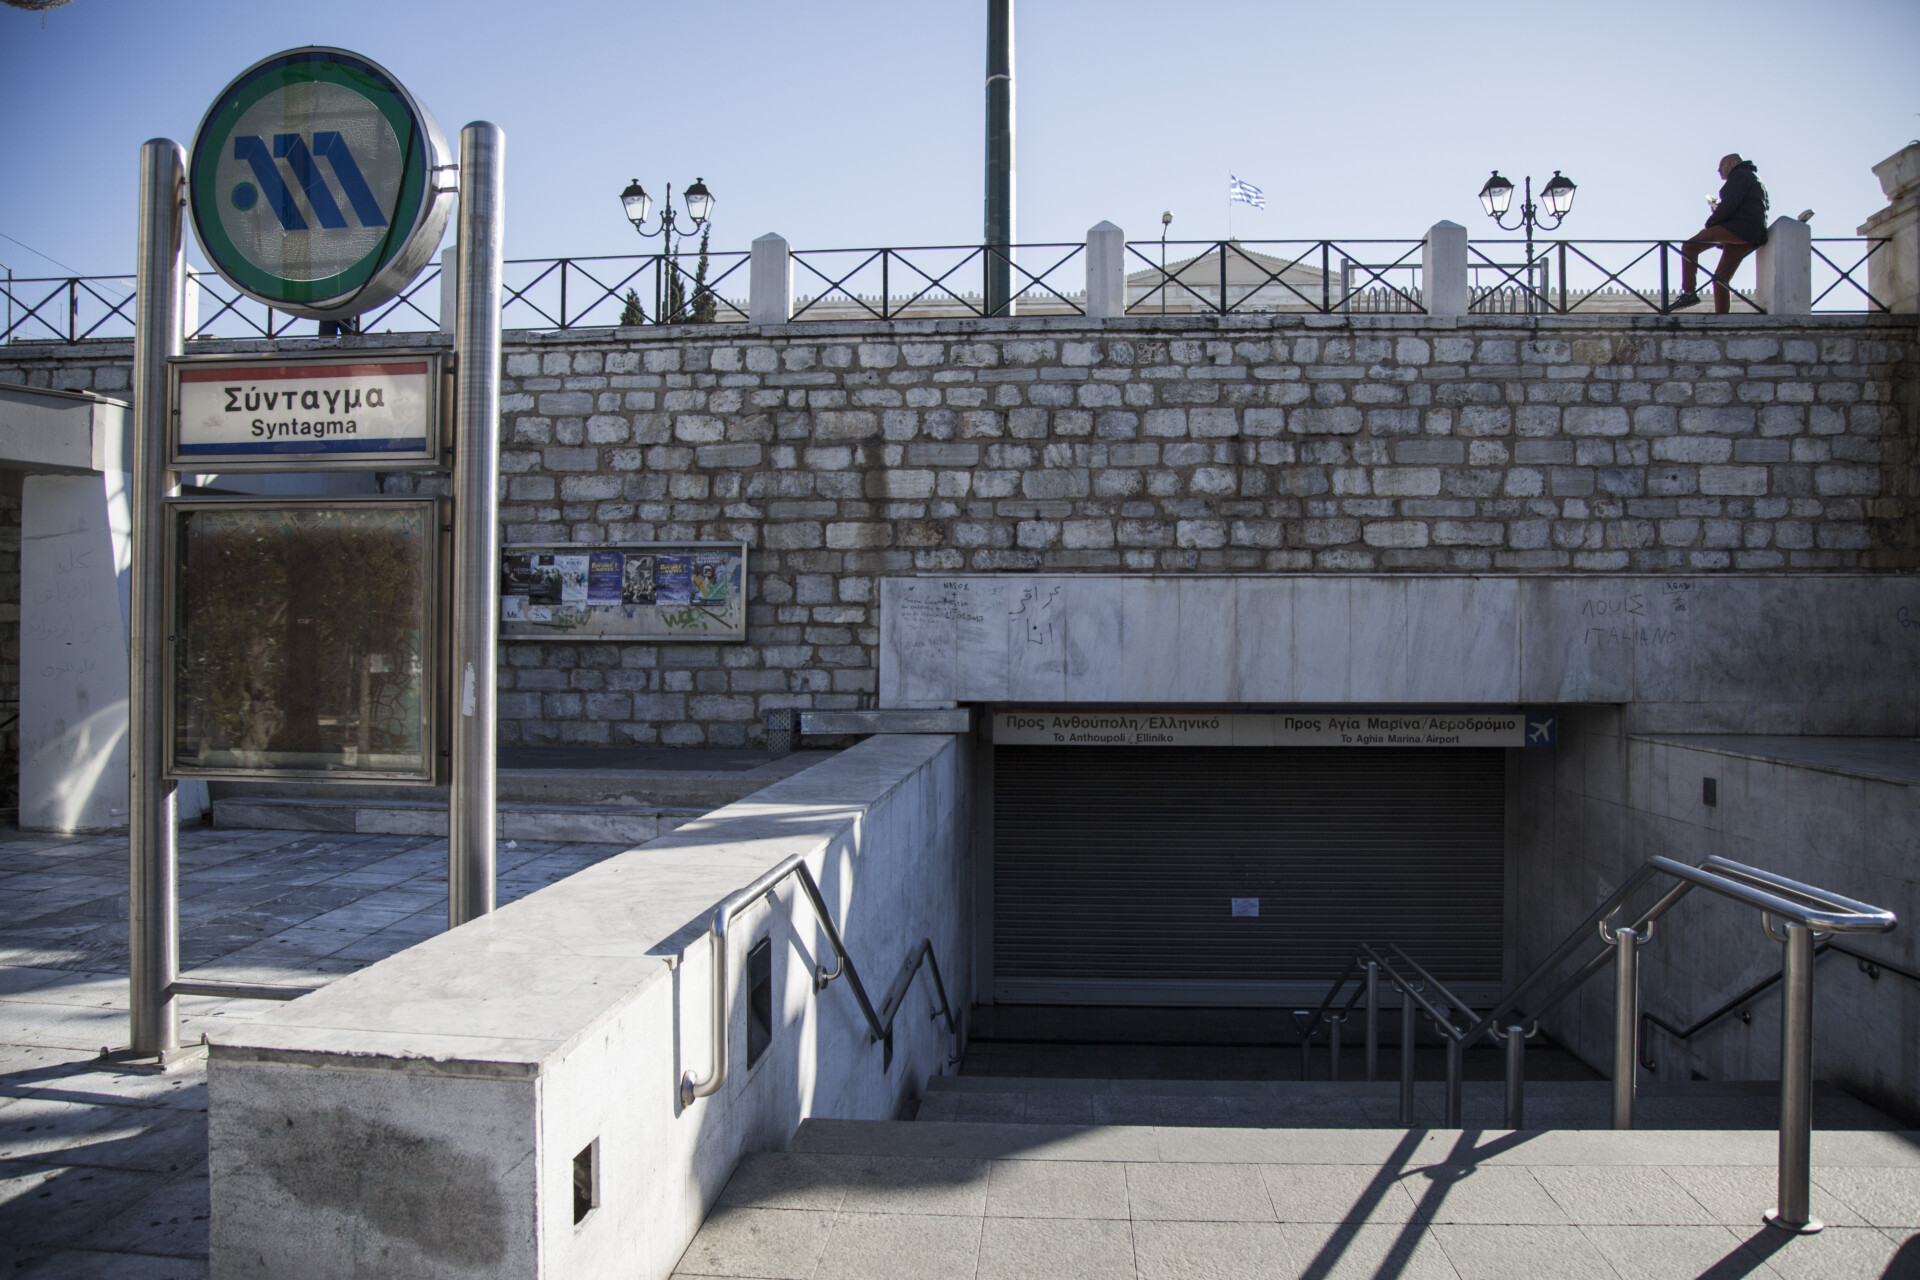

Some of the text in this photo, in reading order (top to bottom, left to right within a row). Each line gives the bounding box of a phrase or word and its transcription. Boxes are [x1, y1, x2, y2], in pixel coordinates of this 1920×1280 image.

[224, 385, 385, 415] Σύνταγμα
[251, 418, 357, 439] Syntagma
[1006, 715, 1045, 731] Προς
[1284, 717, 1322, 731] Προς
[1328, 716, 1361, 731] Αγία
[1053, 733, 1065, 743] To
[1341, 734, 1352, 743] To
[1356, 734, 1384, 745] Aghia
